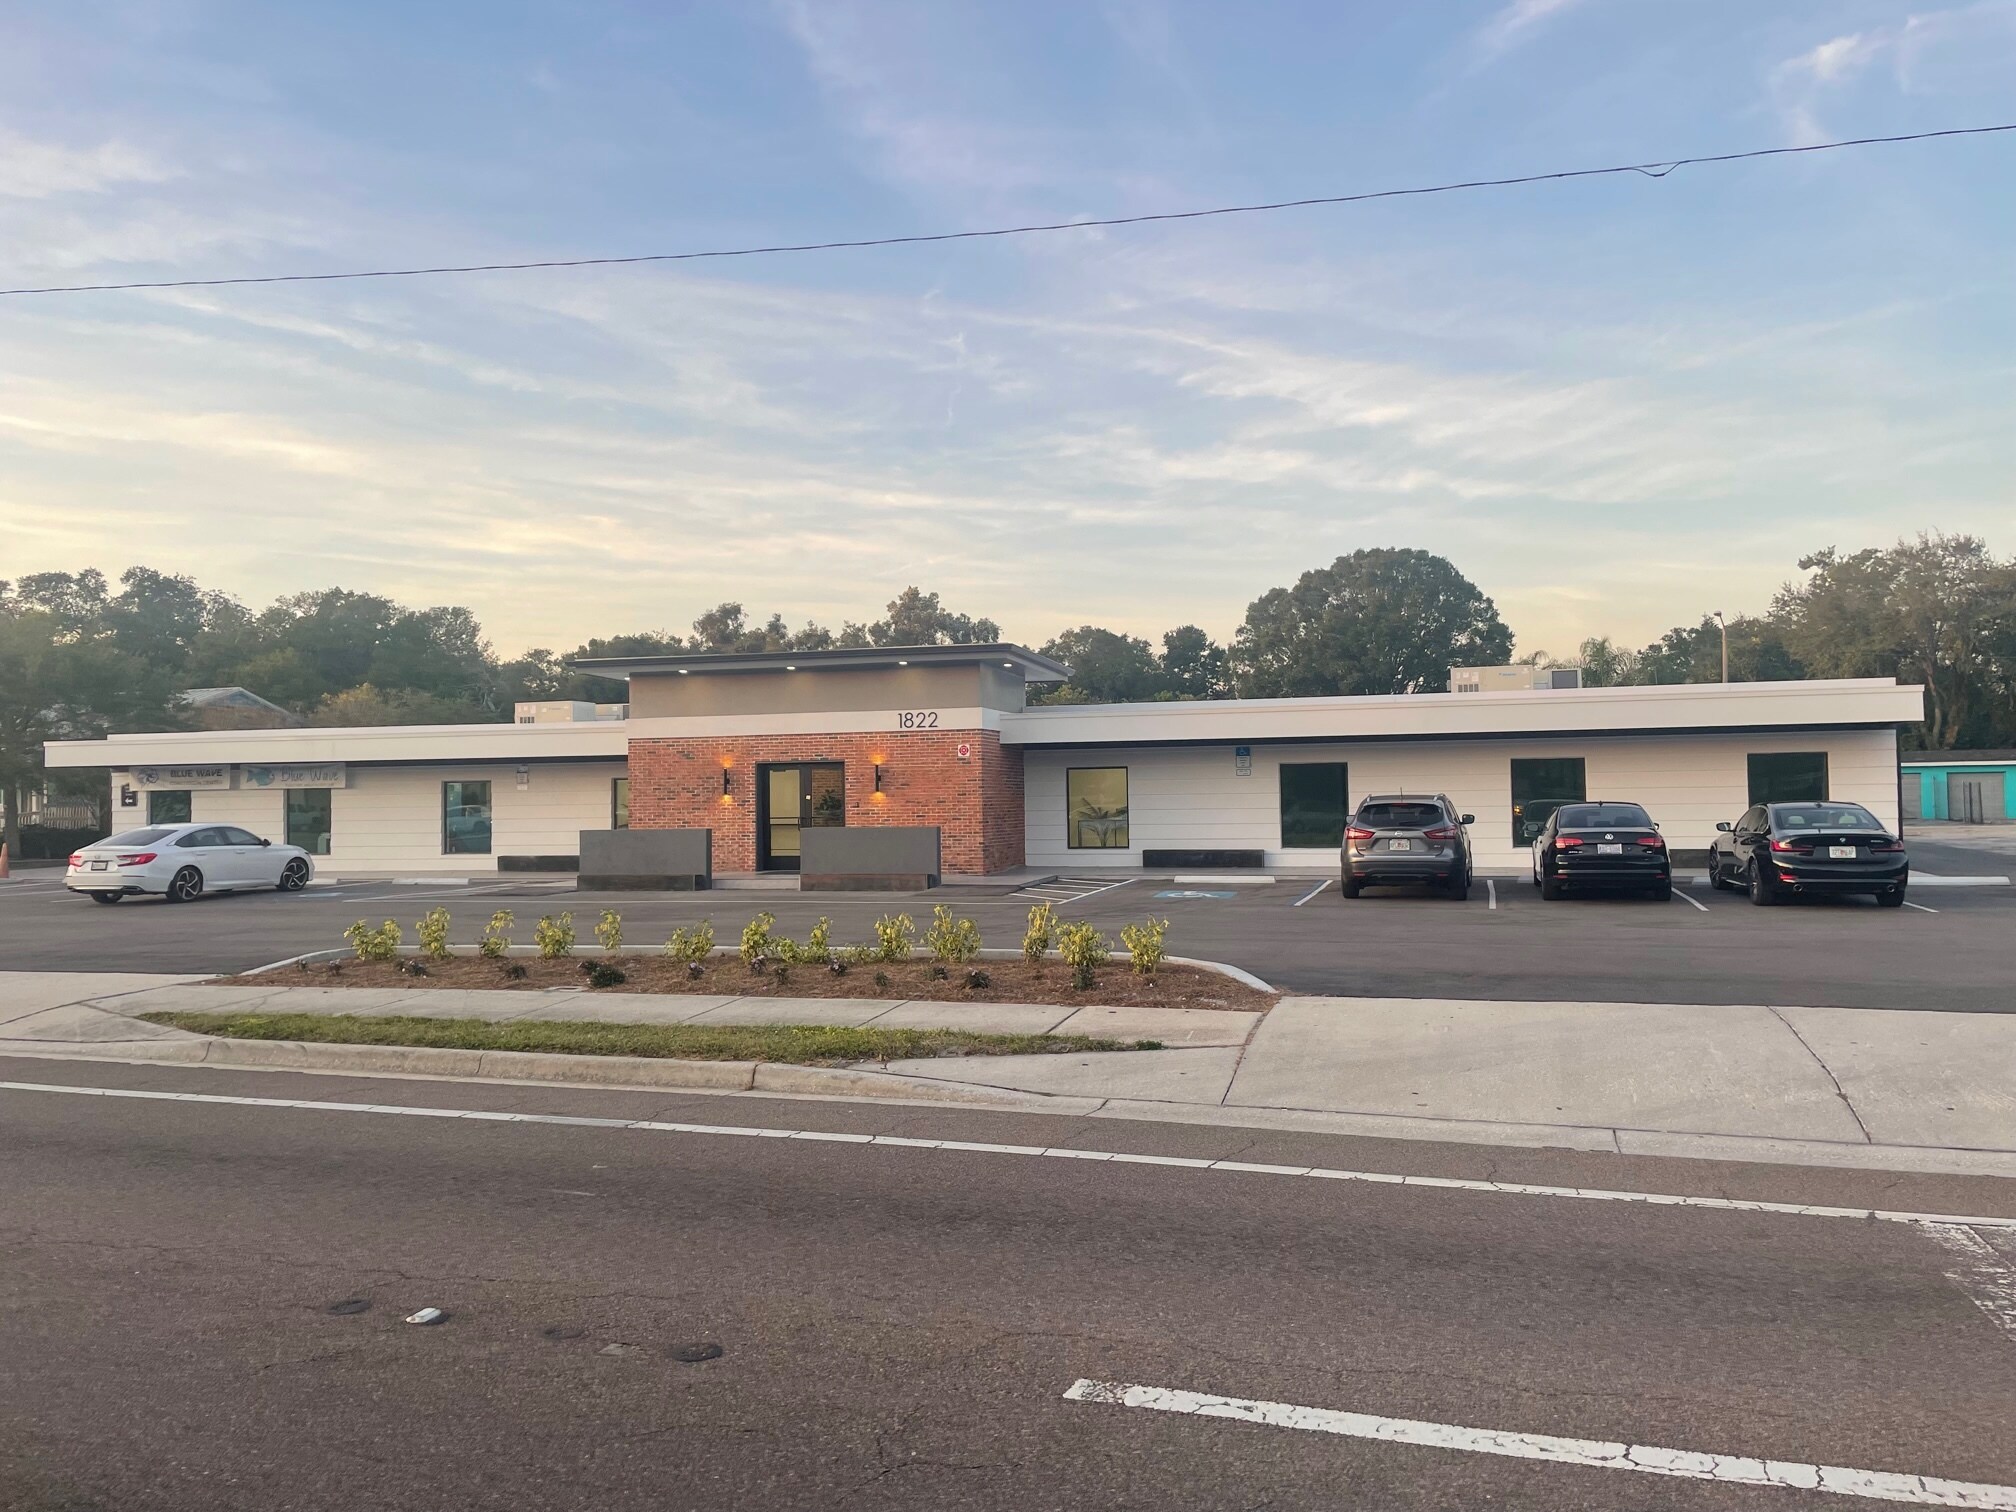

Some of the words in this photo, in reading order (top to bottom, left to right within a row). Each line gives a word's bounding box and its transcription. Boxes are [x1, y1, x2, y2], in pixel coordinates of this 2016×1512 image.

[898, 712, 938, 729] 1822
[170, 769, 193, 778] BLUE
[196, 768, 223, 777] WAVE
